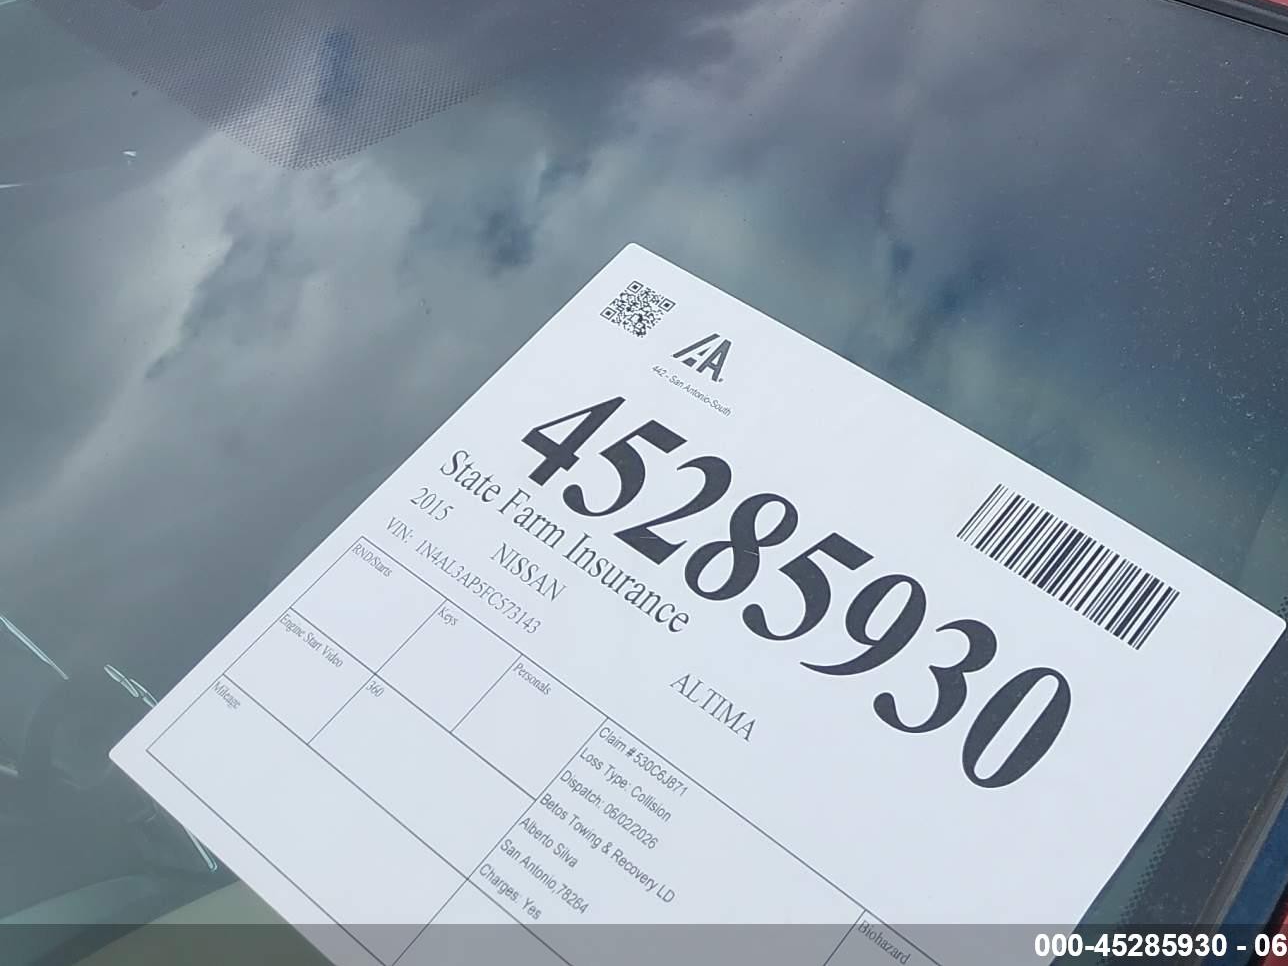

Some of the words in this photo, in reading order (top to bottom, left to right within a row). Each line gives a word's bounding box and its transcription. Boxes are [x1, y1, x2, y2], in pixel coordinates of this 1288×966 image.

[653, 366, 667, 378] 442
[670, 376, 684, 388] San
[685, 385, 731, 416] Antonio-South
[351, 542, 392, 578] RND/Starts
[440, 449, 502, 503] State
[498, 488, 565, 548] Farm
[563, 531, 689, 633] Insurance
[386, 516, 413, 545] VIN:
[415, 539, 541, 633] 1N4AL3AP5FC573143
[521, 396, 1072, 789] 45285930
[410, 486, 453, 521] 2015
[490, 542, 567, 601] NISSAN
[669, 673, 756, 741] ALTIMA
[438, 606, 457, 626] Keys
[279, 613, 305, 639] Engine
[302, 631, 322, 651] Start
[321, 644, 343, 668] Video
[211, 681, 241, 710] Mileage
[364, 679, 384, 698] 360
[512, 662, 551, 695] Personals
[598, 726, 627, 752] Claim
[559, 769, 604, 808] Dispatch:
[602, 801, 659, 849] 06/02/2026
[579, 747, 604, 770] Loss
[603, 763, 630, 792] Type:
[630, 785, 672, 822] Collision
[499, 838, 520, 860] San
[519, 816, 553, 848] Alberto
[552, 842, 578, 868] Silva
[539, 792, 568, 820] Betos
[567, 813, 603, 848] Towing
[600, 840, 613, 855] &
[610, 848, 658, 892] Recovery
[655, 883, 675, 904] LD
[479, 862, 520, 901] Charges:
[520, 897, 542, 920] Yes
[857, 920, 910, 964] Biohazard
